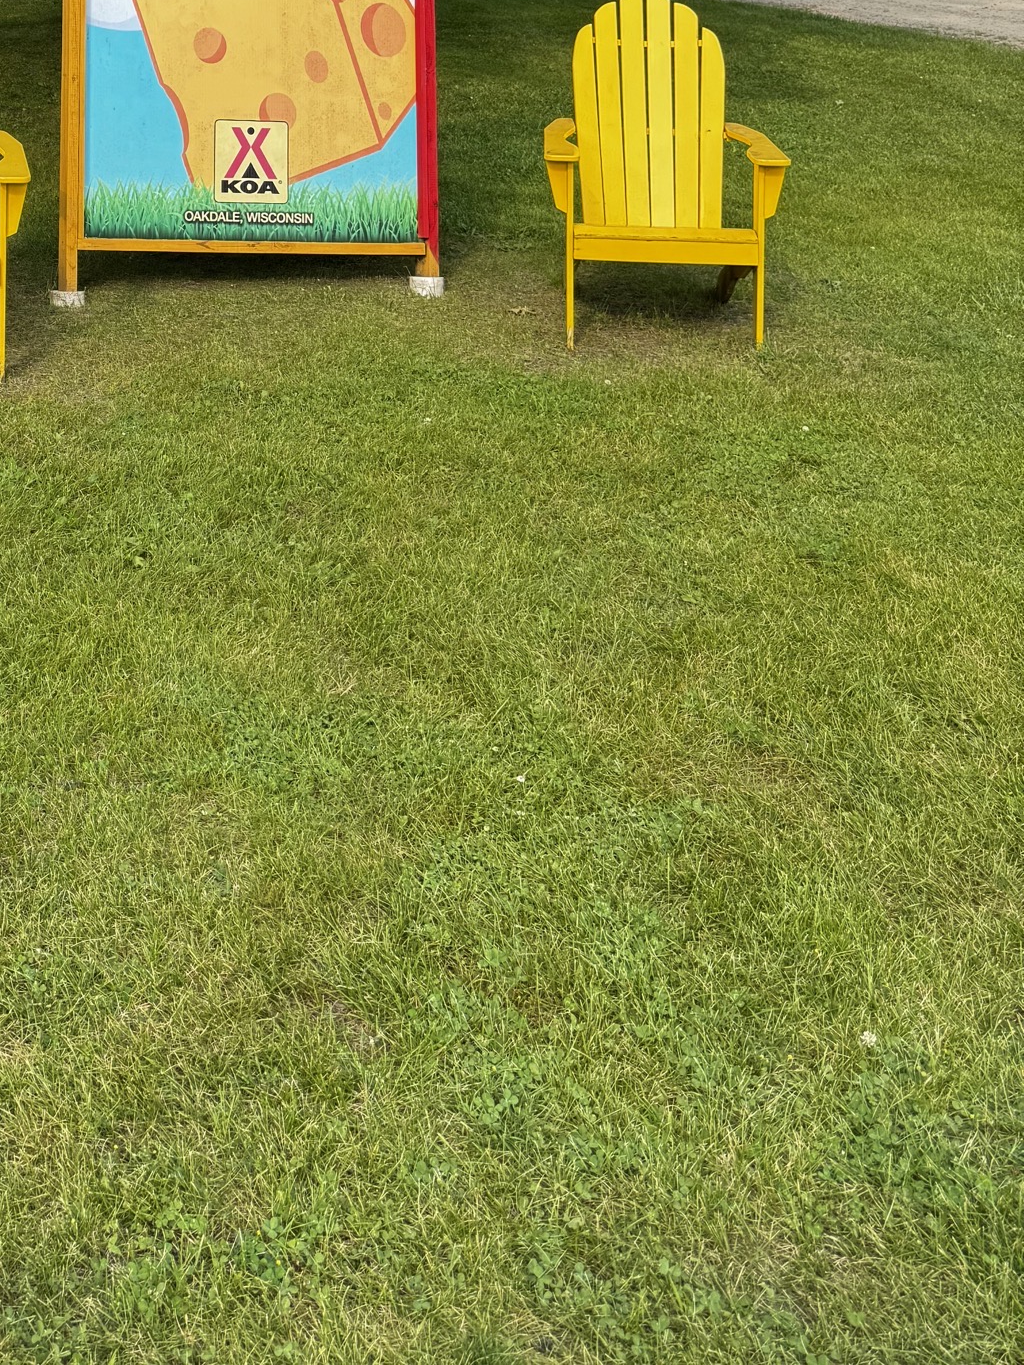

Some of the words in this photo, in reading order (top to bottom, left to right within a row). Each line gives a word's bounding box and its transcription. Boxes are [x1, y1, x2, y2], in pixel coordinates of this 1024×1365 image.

[221, 180, 280, 194] KOA
[184, 210, 243, 224] OAKDALE,
[246, 212, 314, 224] WISCONSIN
